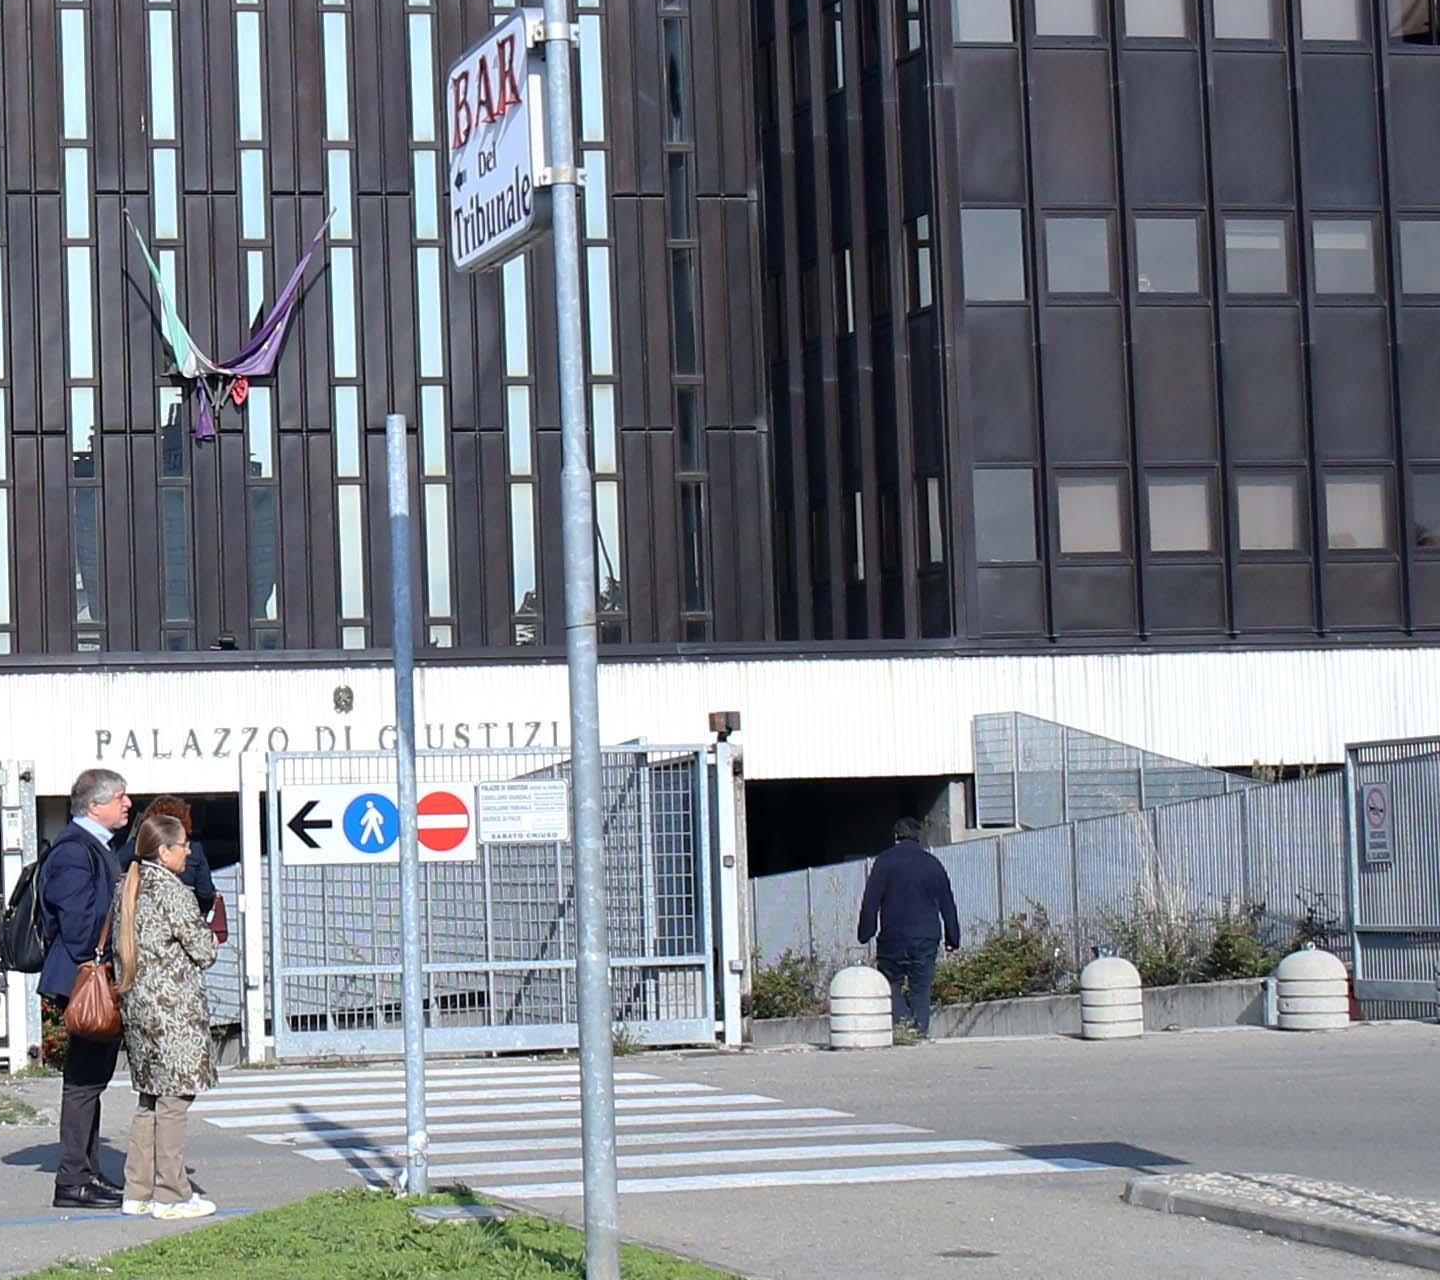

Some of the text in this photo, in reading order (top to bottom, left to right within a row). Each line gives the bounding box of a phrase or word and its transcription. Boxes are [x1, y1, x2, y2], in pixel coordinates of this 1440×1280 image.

[451, 33, 523, 151] BAR
[478, 141, 497, 178] Del
[454, 164, 532, 260] Tribunale
[95, 721, 561, 760] PALAZZO DI GUSTIZI
